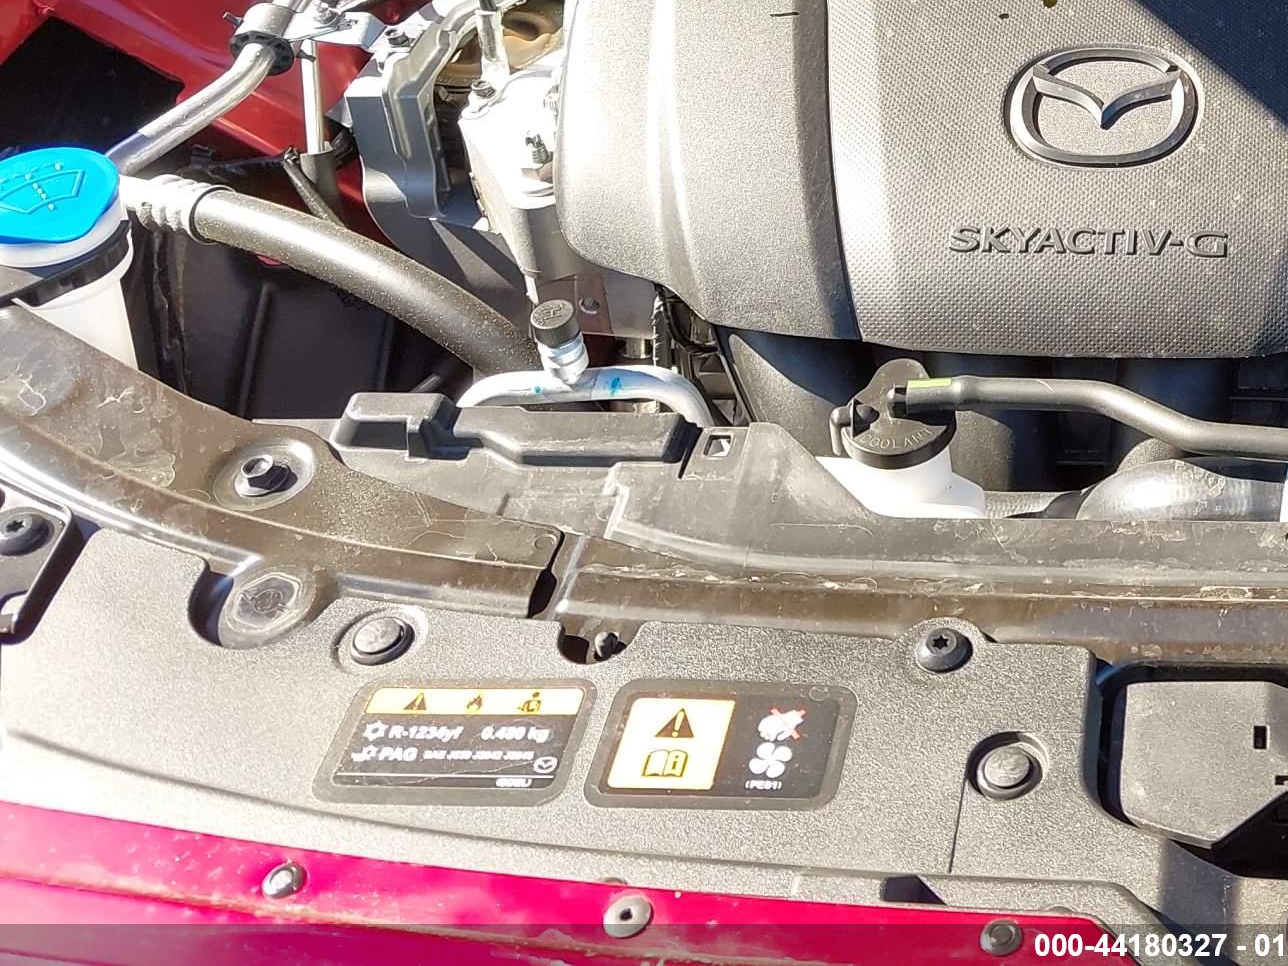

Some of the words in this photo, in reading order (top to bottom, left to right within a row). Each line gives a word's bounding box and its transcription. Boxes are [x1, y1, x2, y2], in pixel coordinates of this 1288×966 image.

[949, 225, 1229, 258] SKYACTIV-G
[860, 427, 934, 449] COOLANT
[388, 724, 464, 743] R-1234yf
[378, 745, 419, 762] PAG
